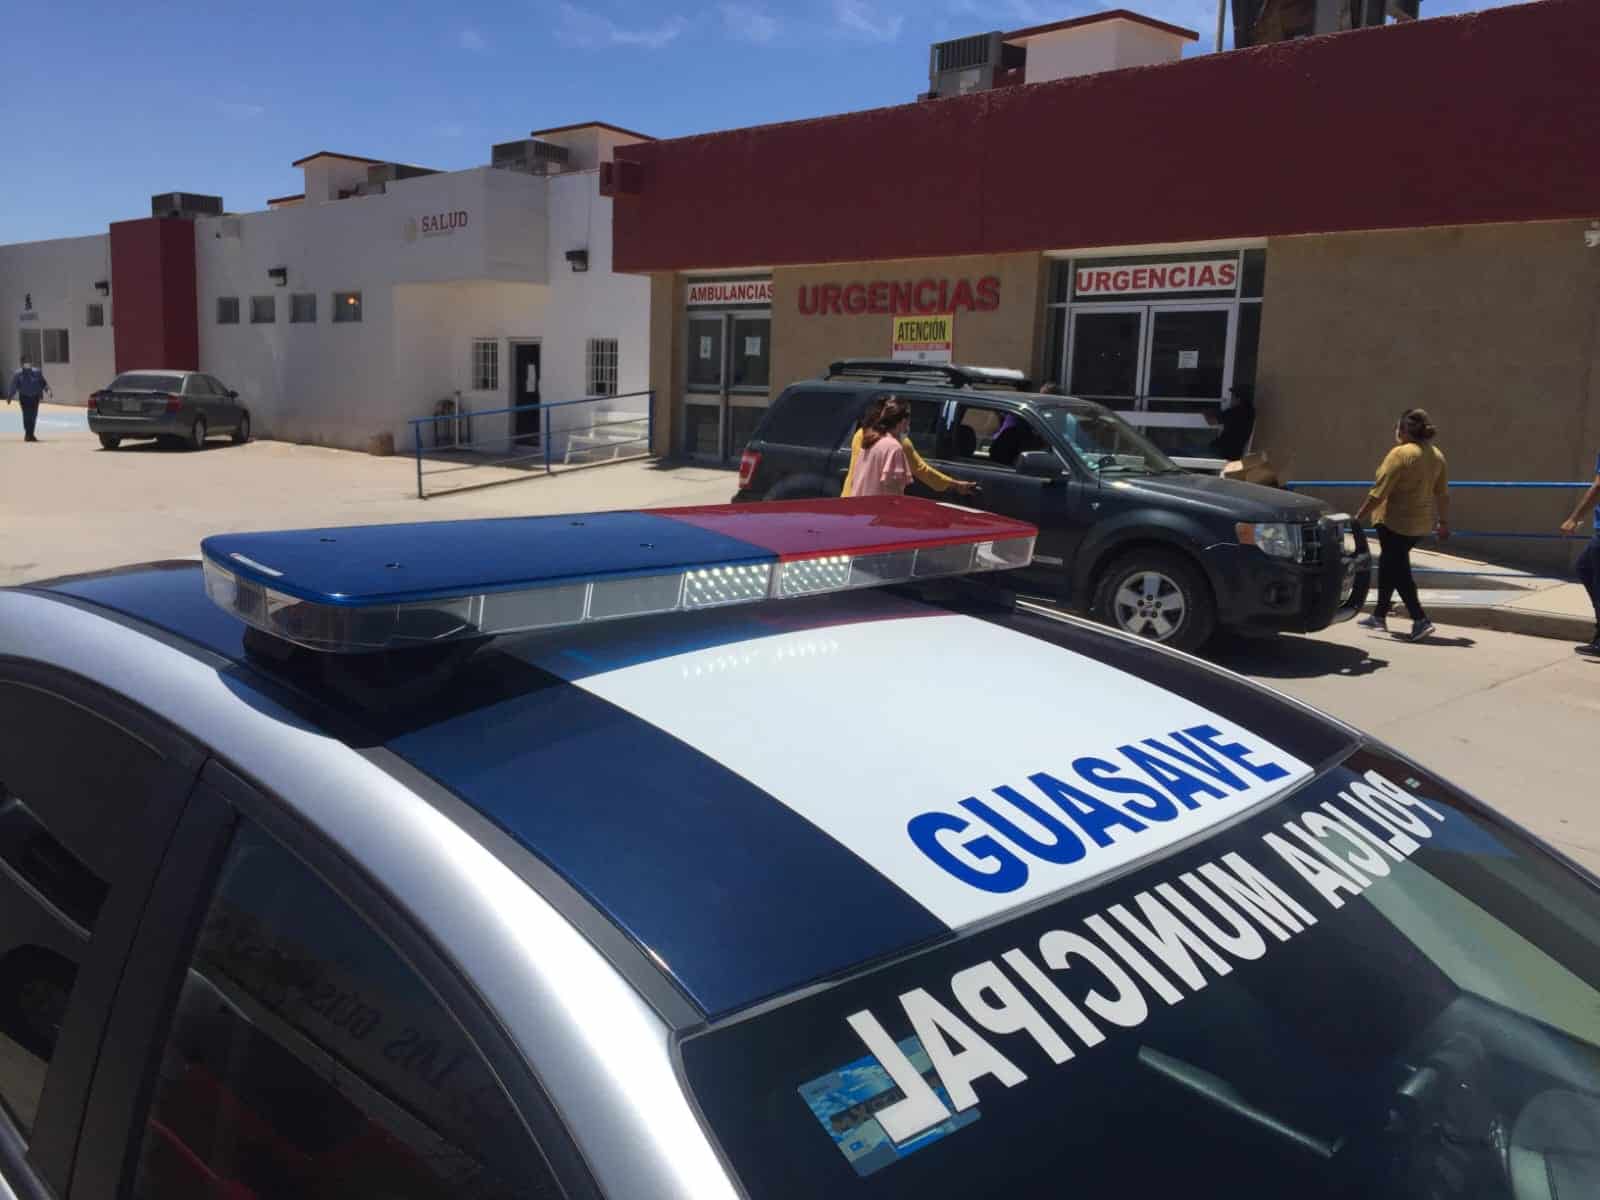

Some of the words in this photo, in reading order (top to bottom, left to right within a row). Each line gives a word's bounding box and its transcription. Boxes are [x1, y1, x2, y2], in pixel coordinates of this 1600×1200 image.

[422, 211, 468, 232] SALUD
[1076, 263, 1235, 292] URGENCIAS
[690, 284, 774, 301] AMBULANCIAS
[799, 277, 1000, 315] URGENCIAS
[898, 317, 946, 341] ATENCIÓN
[907, 724, 1292, 894] GUASAVE
